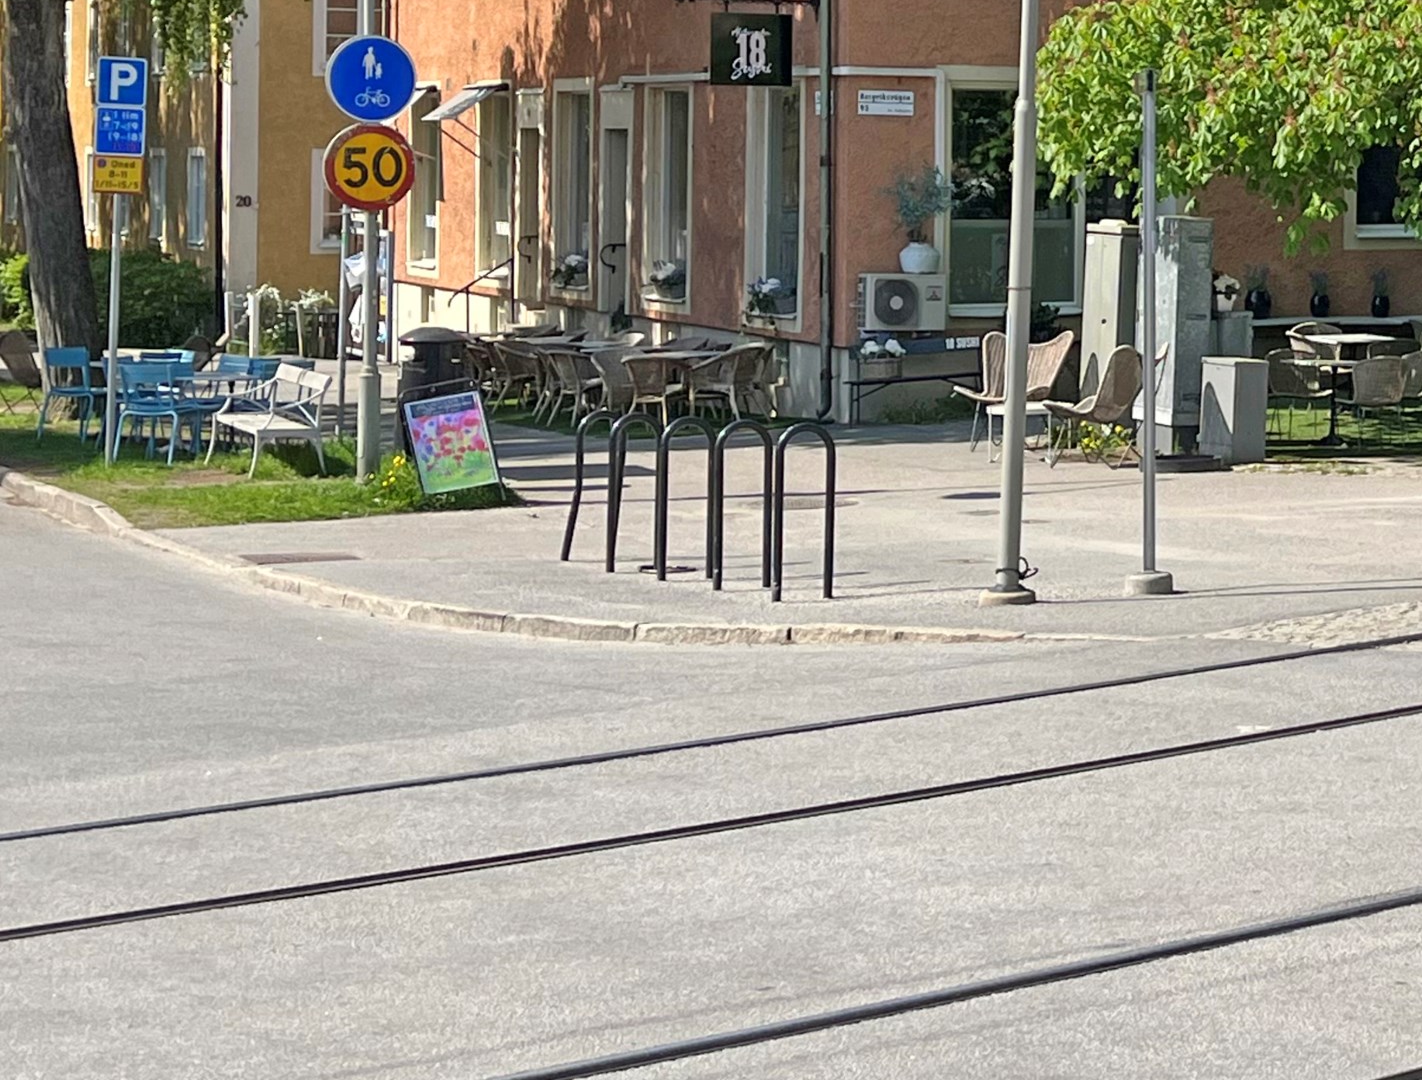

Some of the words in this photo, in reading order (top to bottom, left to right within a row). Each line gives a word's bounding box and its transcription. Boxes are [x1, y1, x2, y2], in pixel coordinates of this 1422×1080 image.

[736, 31, 766, 67] 18
[110, 62, 138, 101] P
[343, 146, 402, 188] 50
[235, 194, 252, 207] 20
